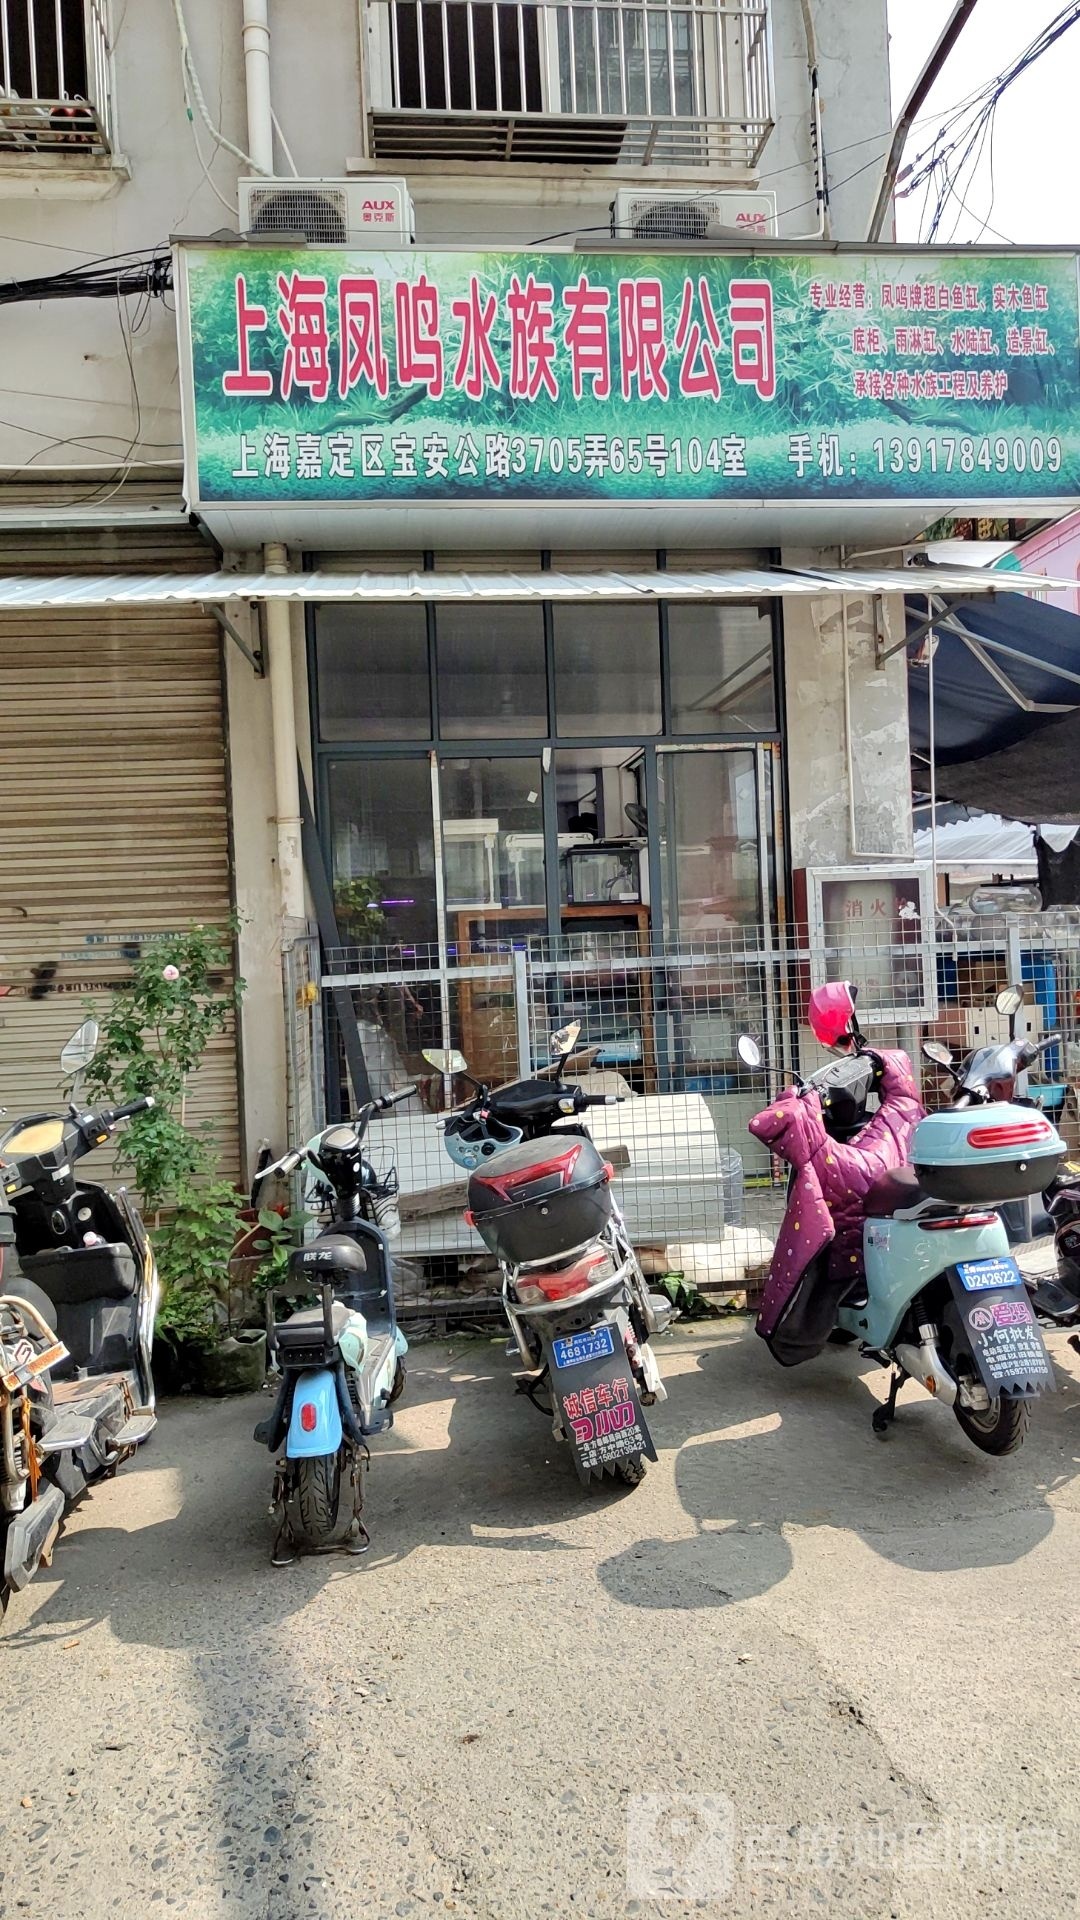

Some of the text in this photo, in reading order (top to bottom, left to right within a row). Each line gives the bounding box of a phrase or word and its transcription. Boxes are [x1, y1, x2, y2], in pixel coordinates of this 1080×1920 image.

[362, 200, 395, 210] AUX
[222, 275, 776, 402] 上海凤鸣水族有限公司
[854, 371, 1008, 400] 承接各种水族工程及养护
[231, 433, 747, 479] 上海嘉定区宝安公路3705弄65号104室
[965, 1270, 1017, 1288] D242622
[560, 1338, 608, 1359] 4681732
[563, 1378, 629, 1420] 诚信车行
